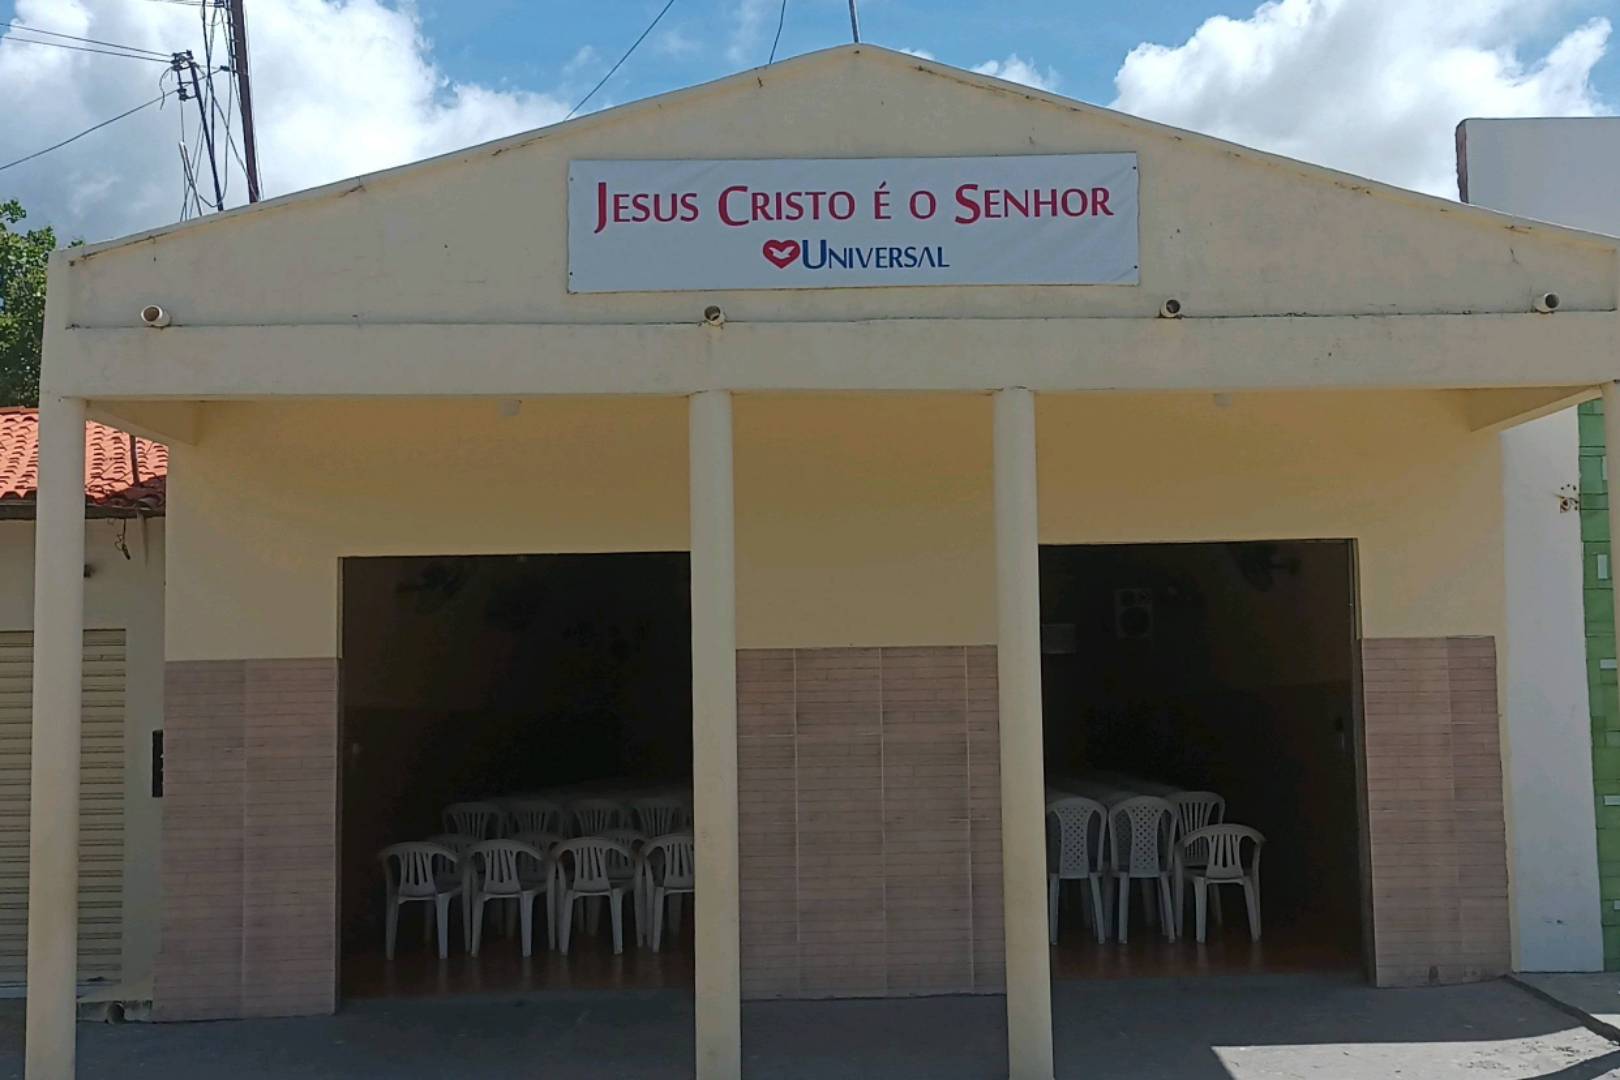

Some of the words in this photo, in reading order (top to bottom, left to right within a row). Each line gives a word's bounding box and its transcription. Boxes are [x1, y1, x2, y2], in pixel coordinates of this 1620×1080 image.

[594, 182, 700, 233] JESUS
[718, 185, 856, 227] CRISTO
[874, 181, 892, 220] É
[909, 190, 937, 220] O
[955, 183, 1114, 225] SENHOR
[802, 239, 950, 270] UNIVERSAL
